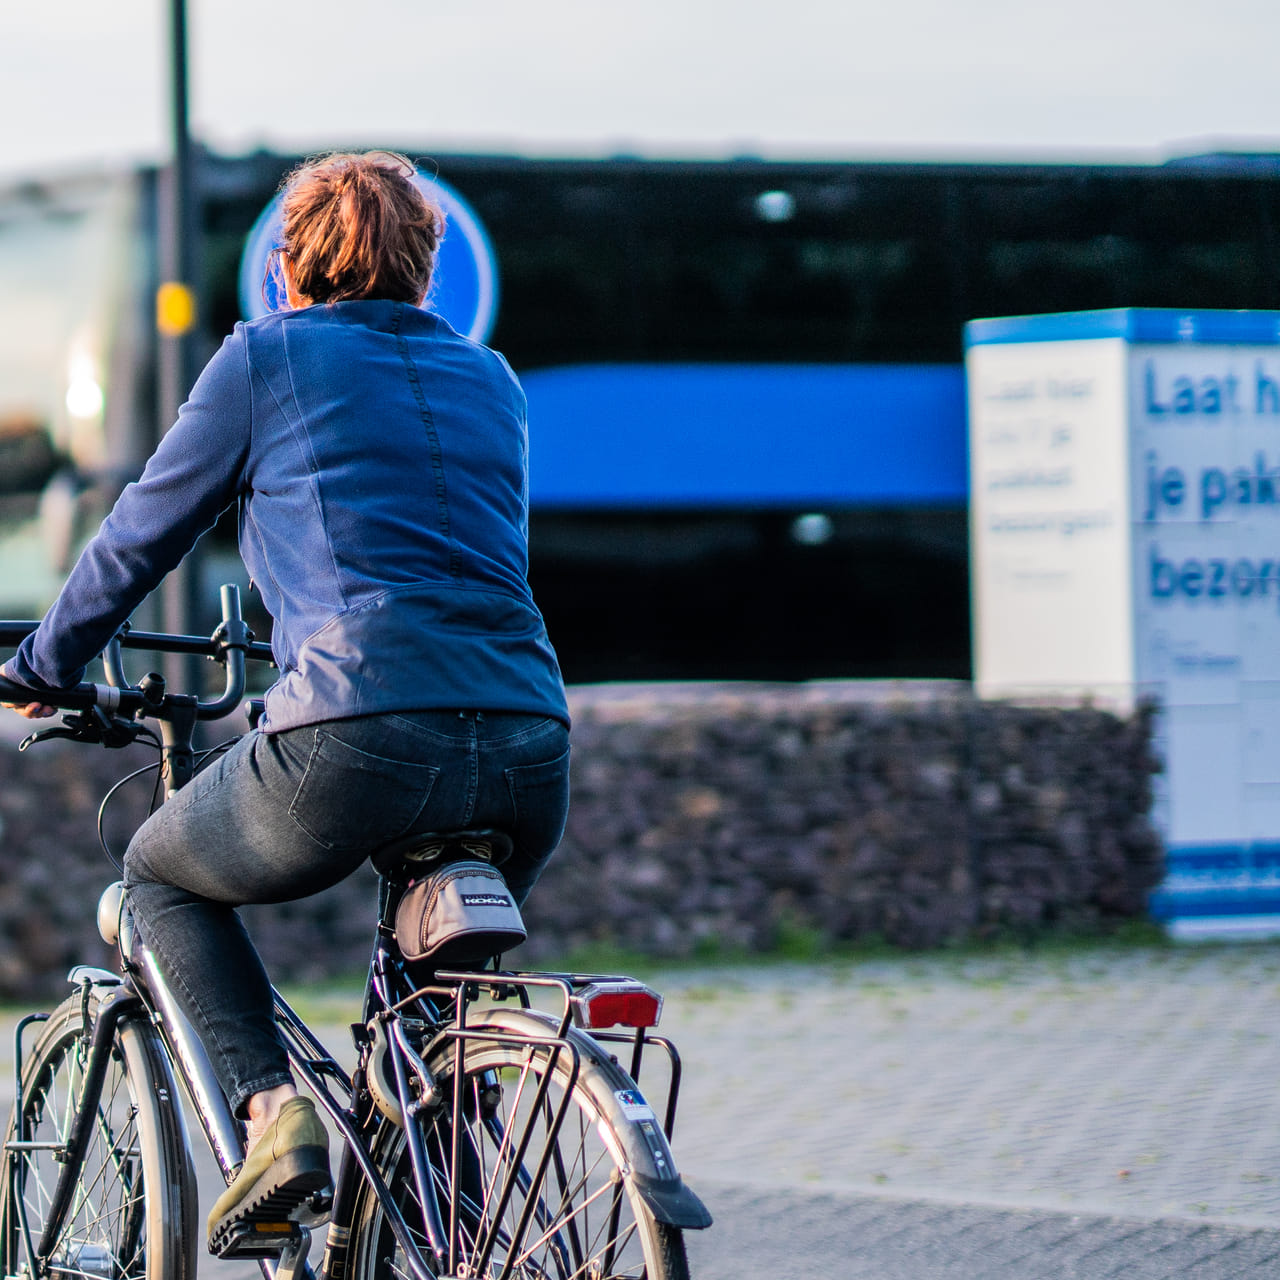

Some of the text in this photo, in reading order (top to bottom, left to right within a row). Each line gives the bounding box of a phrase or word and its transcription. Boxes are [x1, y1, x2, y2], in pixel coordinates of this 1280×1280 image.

[1144, 357, 1240, 416] Laat
[1143, 449, 1185, 524] je
[1149, 541, 1280, 606] bezor
